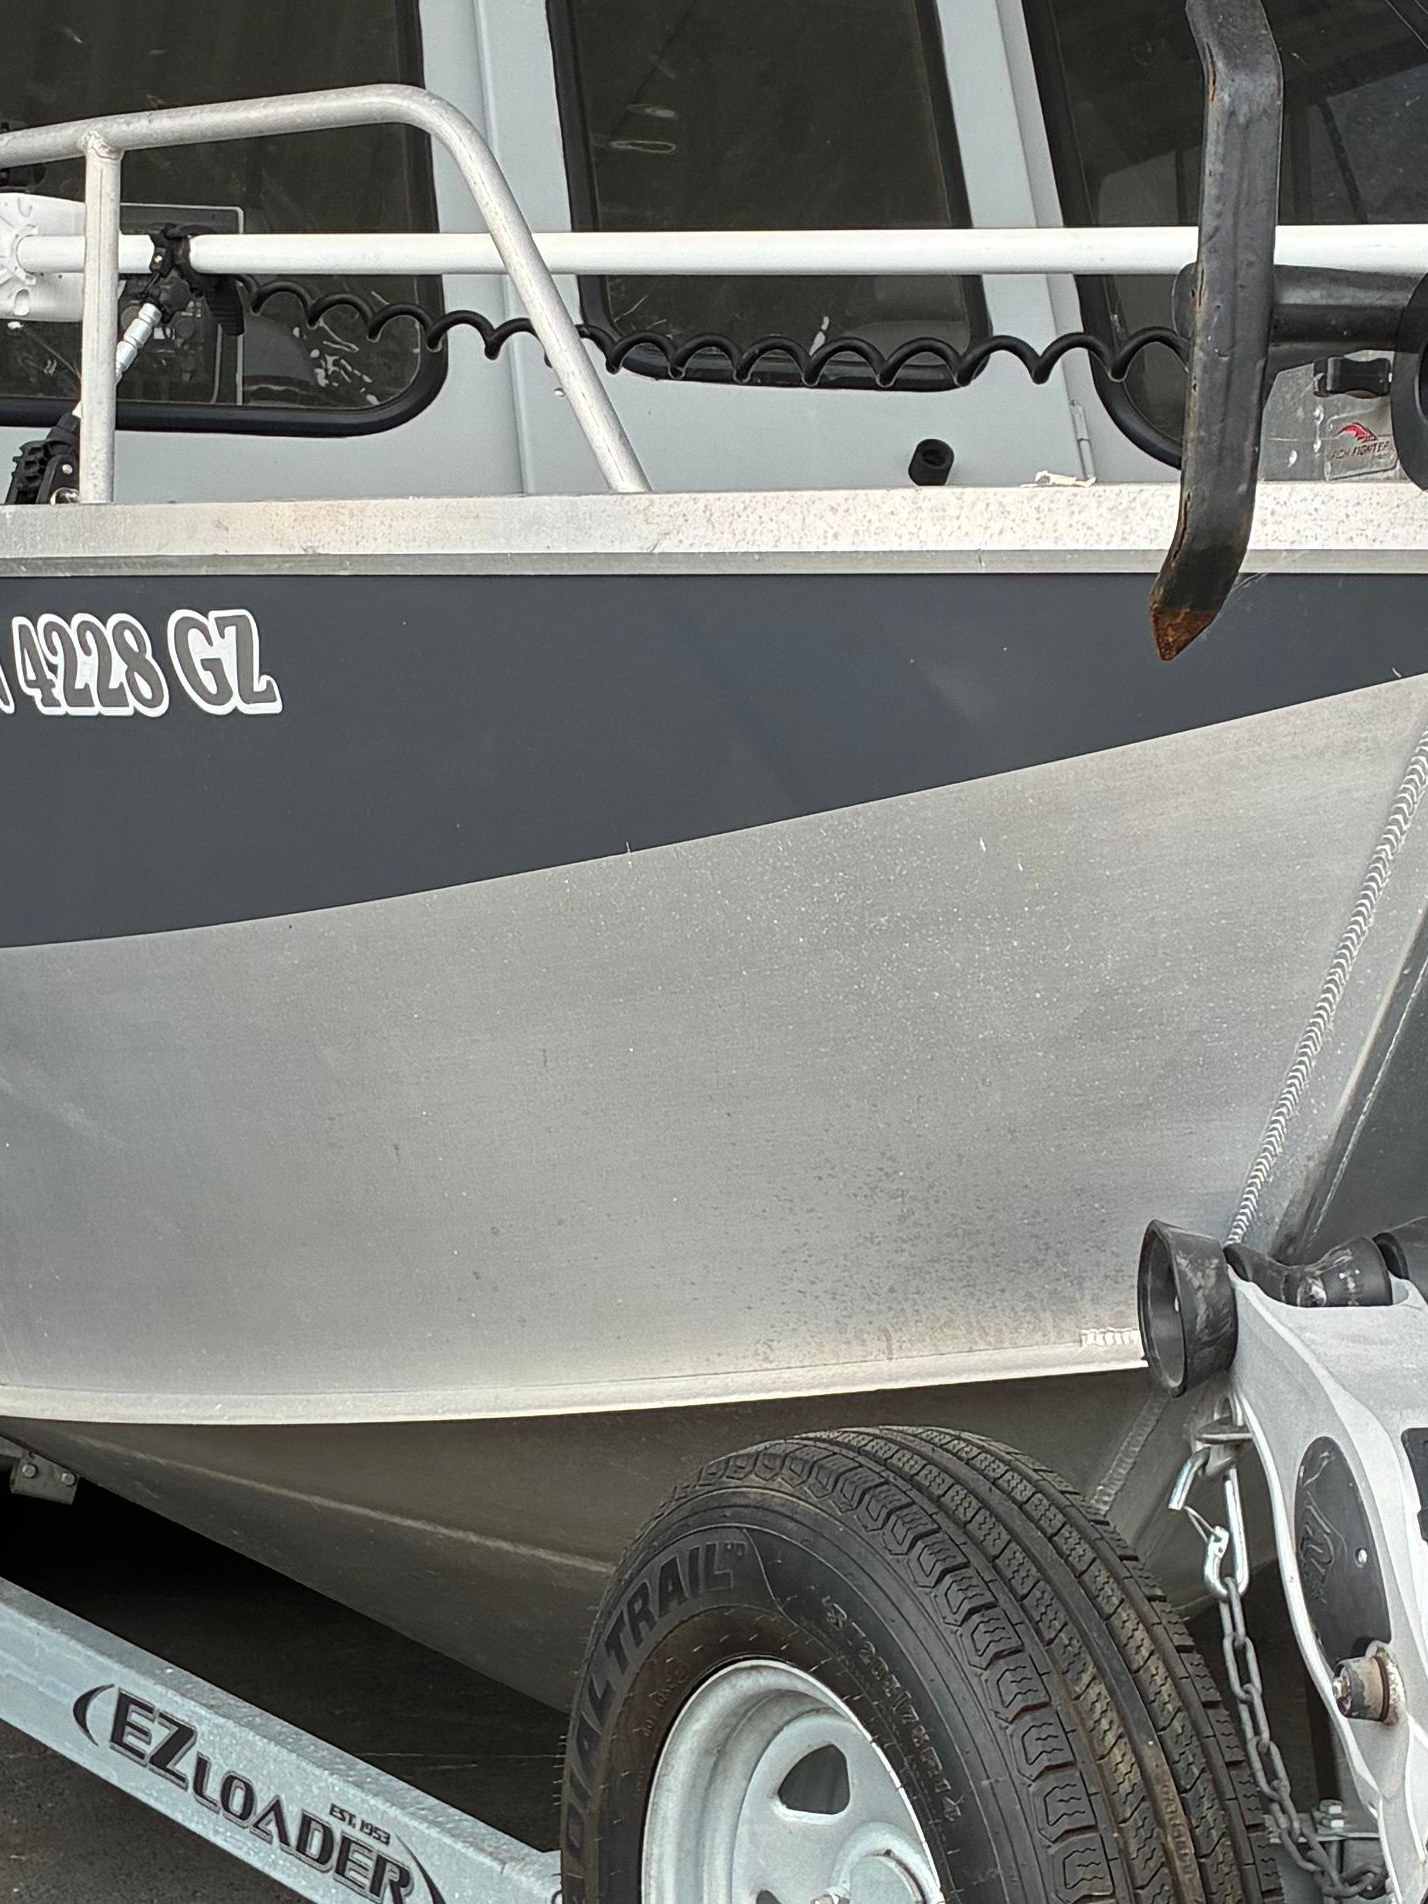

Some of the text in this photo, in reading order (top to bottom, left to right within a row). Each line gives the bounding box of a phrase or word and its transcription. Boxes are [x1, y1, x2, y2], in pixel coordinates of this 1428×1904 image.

[12, 612, 170, 717] 4228
[167, 608, 283, 715] GZ
[604, 1541, 735, 1676] TRAIL
[359, 1819, 391, 1846] 1953
